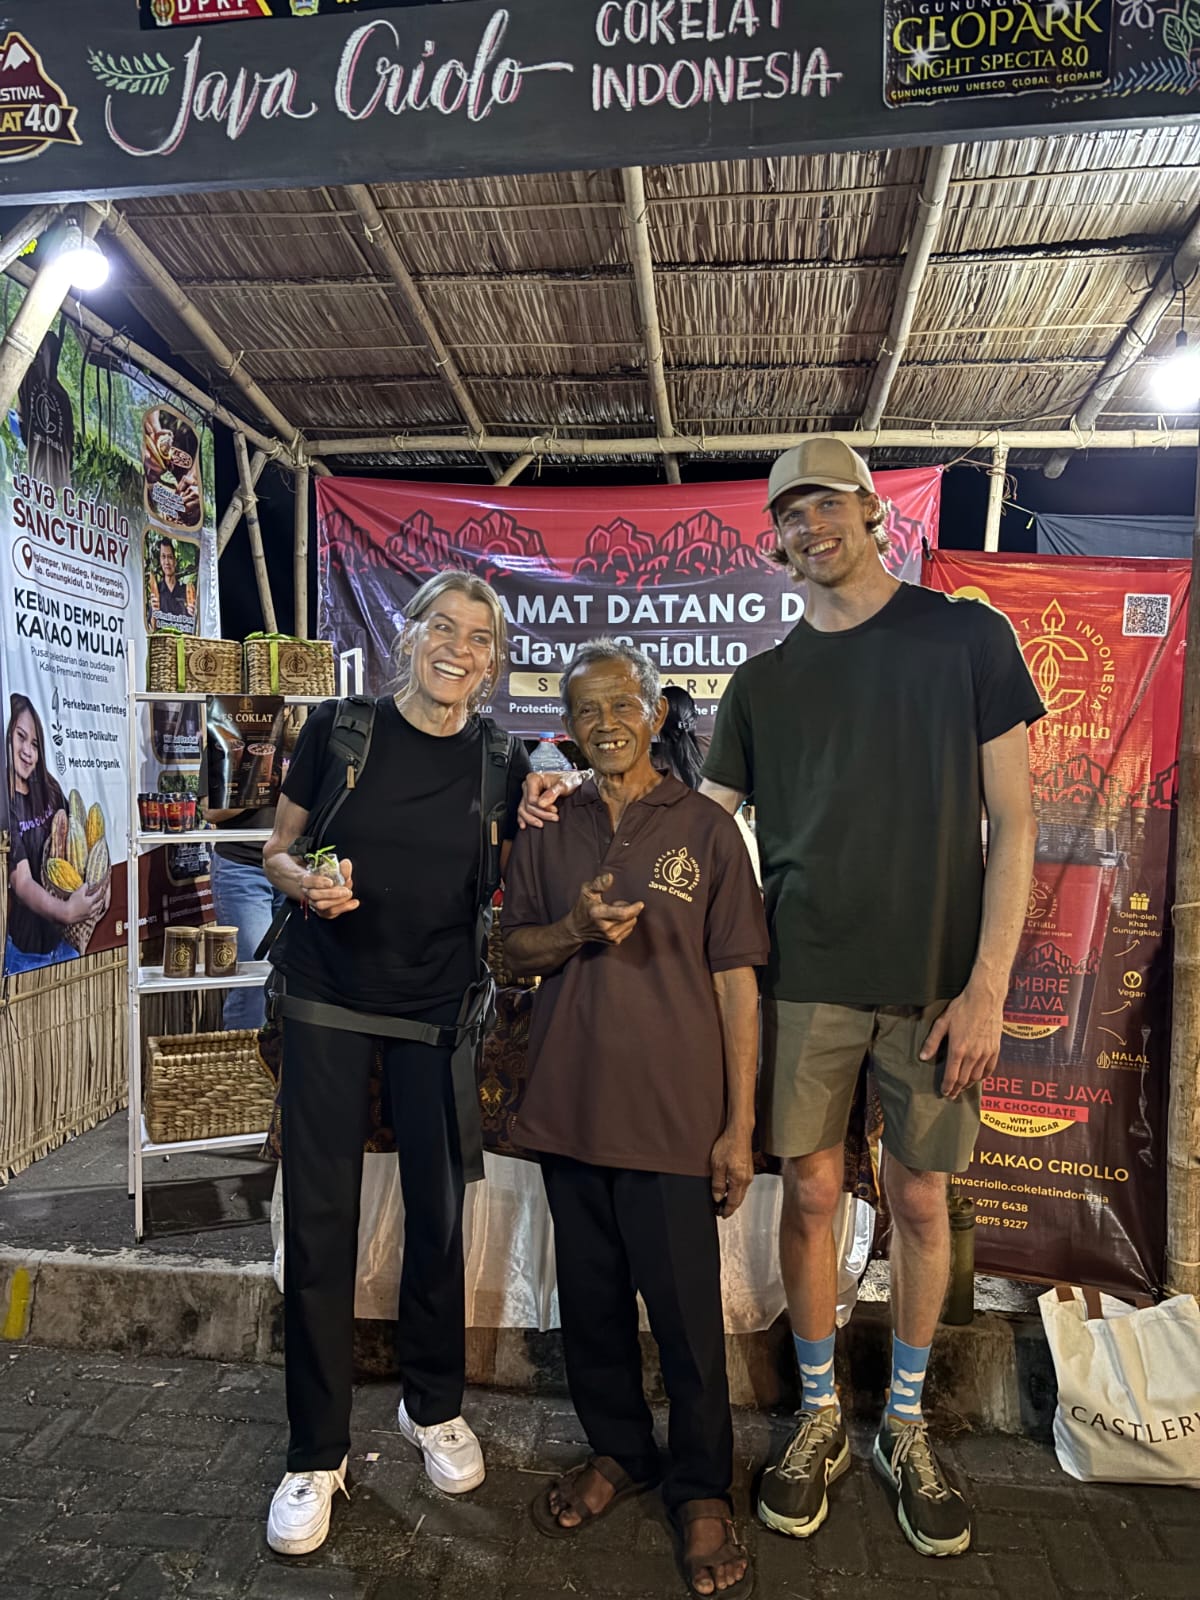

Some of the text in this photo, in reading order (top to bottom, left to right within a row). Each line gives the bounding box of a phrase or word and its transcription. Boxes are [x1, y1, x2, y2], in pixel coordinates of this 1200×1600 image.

[892, 0, 1103, 53] GEOPARK
[905, 46, 1089, 83] NIGHT SPECTA 8.0
[104, 9, 573, 157] Java Criolo
[592, 47, 843, 111] INDONESIA
[891, 70, 1102, 99] GUNUNGSEWU UNESCO GLOBAL GEOPARK
[24, 104, 60, 132] 4.0
[63, 487, 129, 538] Criollo
[13, 497, 129, 567] SANCTUARY
[14, 587, 60, 619] KEBUN
[64, 603, 125, 634] DEMPLOT
[499, 593, 805, 624] AMAT DATANG D
[16, 611, 125, 659] KAKAO MULIA
[30, 646, 49, 658] Pusa
[509, 635, 580, 666] Jav
[1076, 620, 1115, 710] INDONESIA
[62, 697, 101, 713] Perkebunan
[509, 702, 567, 715] Protecting
[235, 713, 274, 723] COKLAT
[65, 729, 118, 742] Sistem Polikultur
[1039, 719, 1111, 740] Criollo
[68, 757, 95, 768] Metode
[648, 880, 693, 903] Java Criollo
[1119, 911, 1157, 921] Oleh-oleh
[1128, 920, 1148, 929] Khas
[1020, 994, 1064, 1012] JAVA
[1118, 988, 1146, 999] Vegan
[1111, 1051, 1150, 1064] HALAL
[982, 1076, 1113, 1105] BRE DE JAVA
[981, 1099, 1077, 1118] RK CHOCOLATE
[983, 1113, 1060, 1134] SORGHUM SUGAR
[1009, 1116, 1033, 1126] WITH
[980, 1151, 1043, 1171] KAKAO
[1048, 1159, 1129, 1182] CRIOLLO
[976, 1197, 1029, 1213] 4717 6438
[975, 1215, 1029, 1230] 6875 9227
